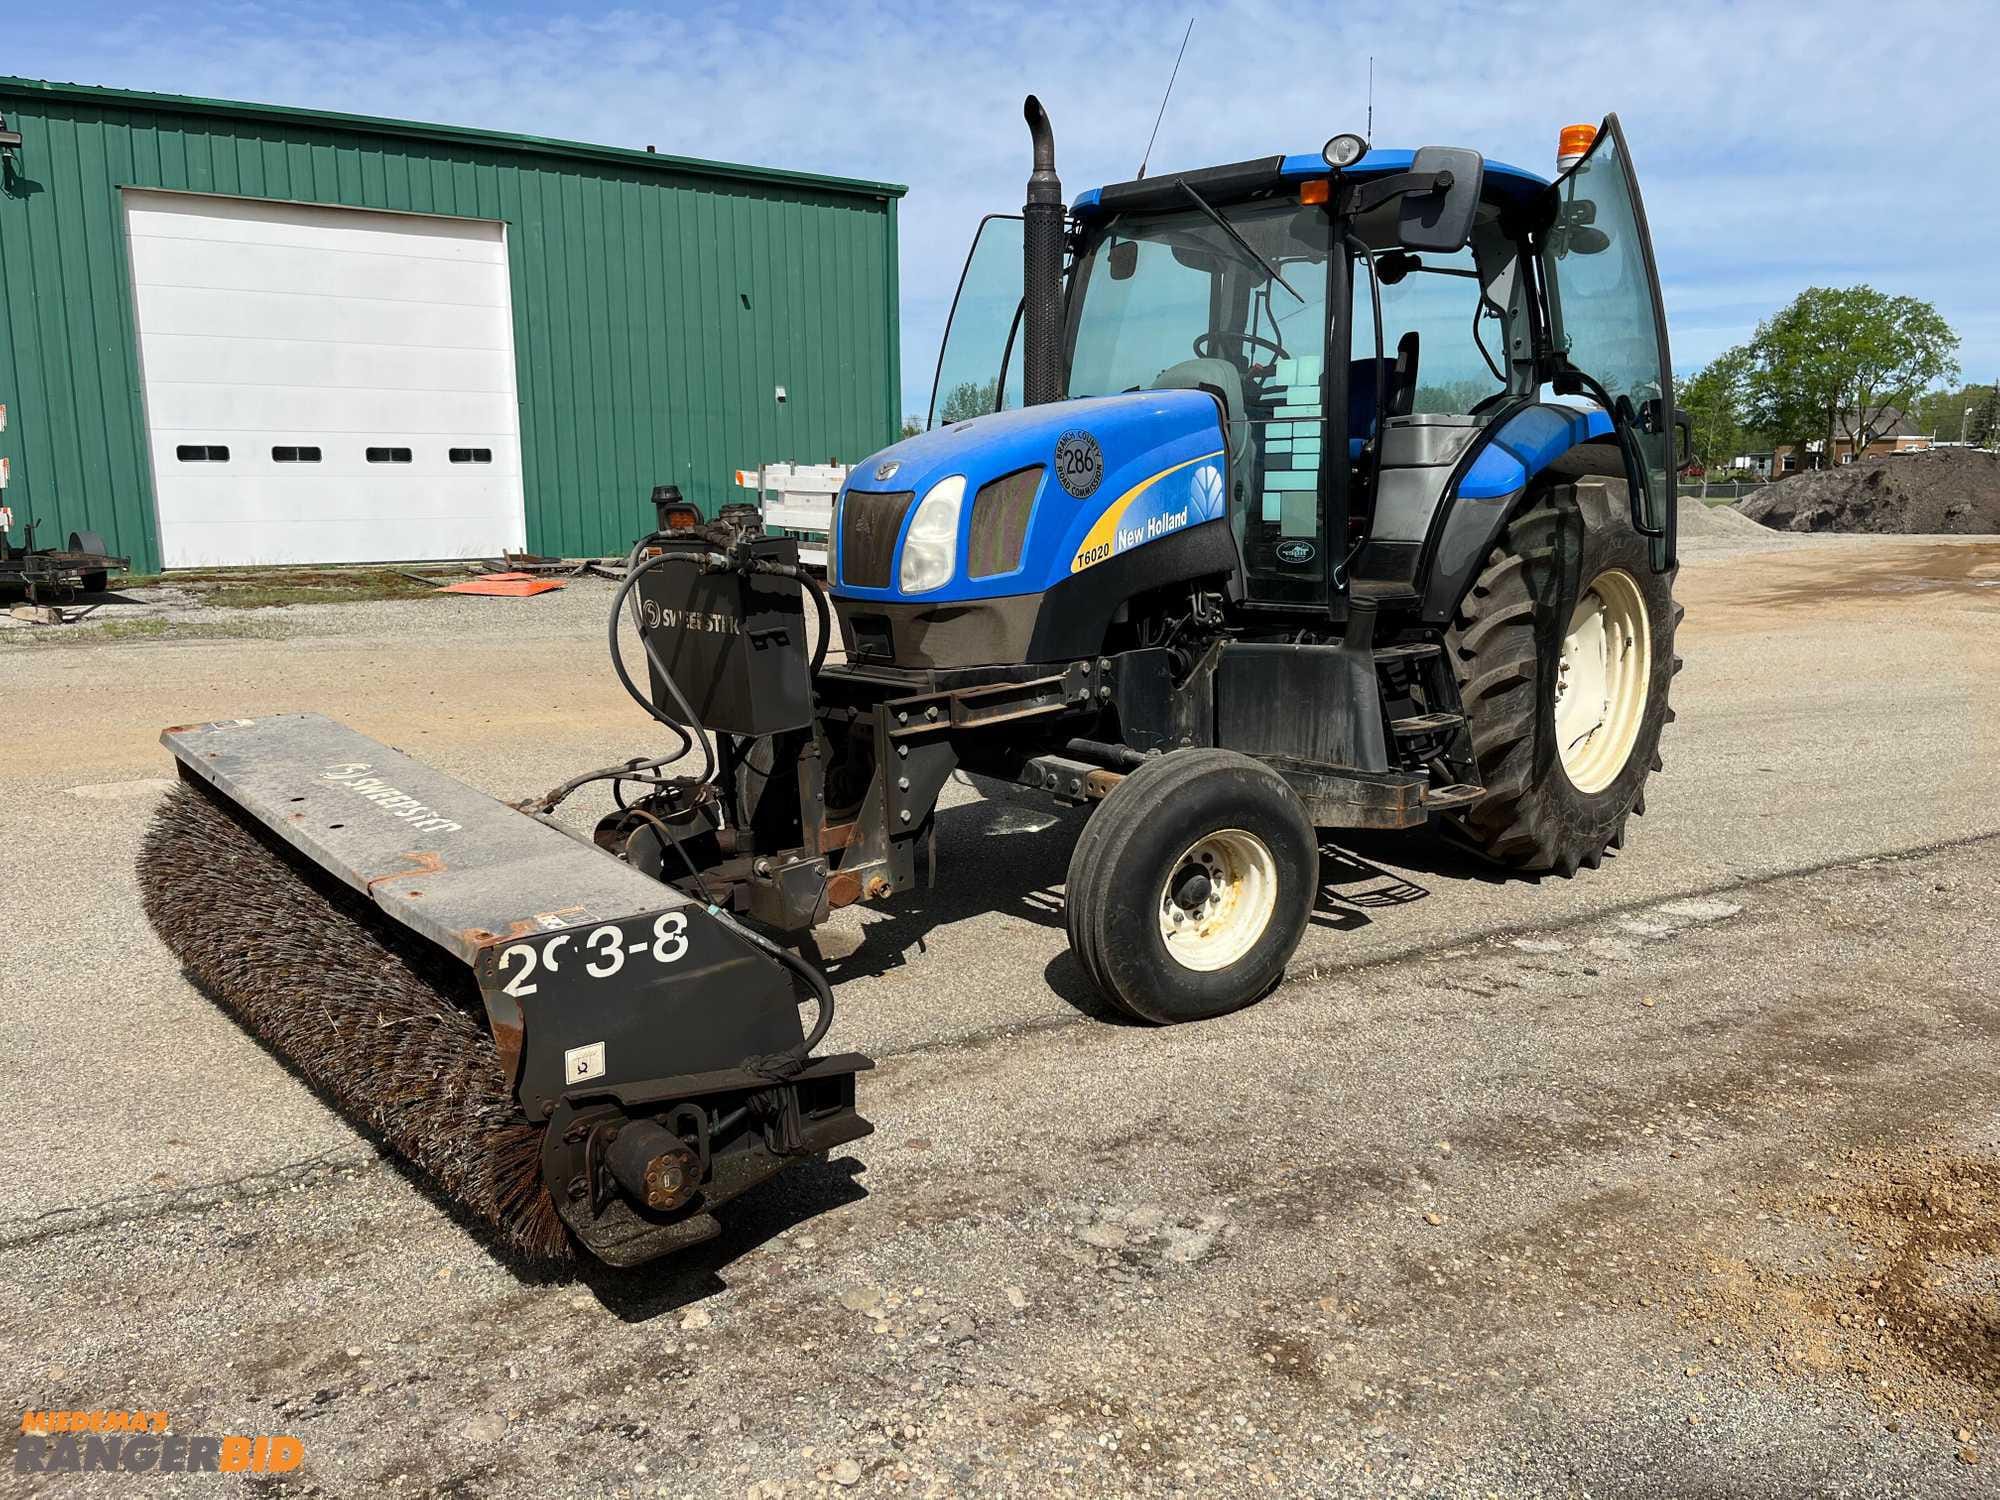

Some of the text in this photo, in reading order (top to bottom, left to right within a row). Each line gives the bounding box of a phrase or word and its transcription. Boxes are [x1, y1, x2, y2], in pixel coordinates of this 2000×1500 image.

[1056, 430, 1101, 460] BRANCH COUNTY
[1064, 447, 1094, 474] 286
[1057, 464, 1103, 497] ROAD COMMISSION
[1118, 506, 1188, 551] New Holland
[1077, 543, 1110, 568] T6020
